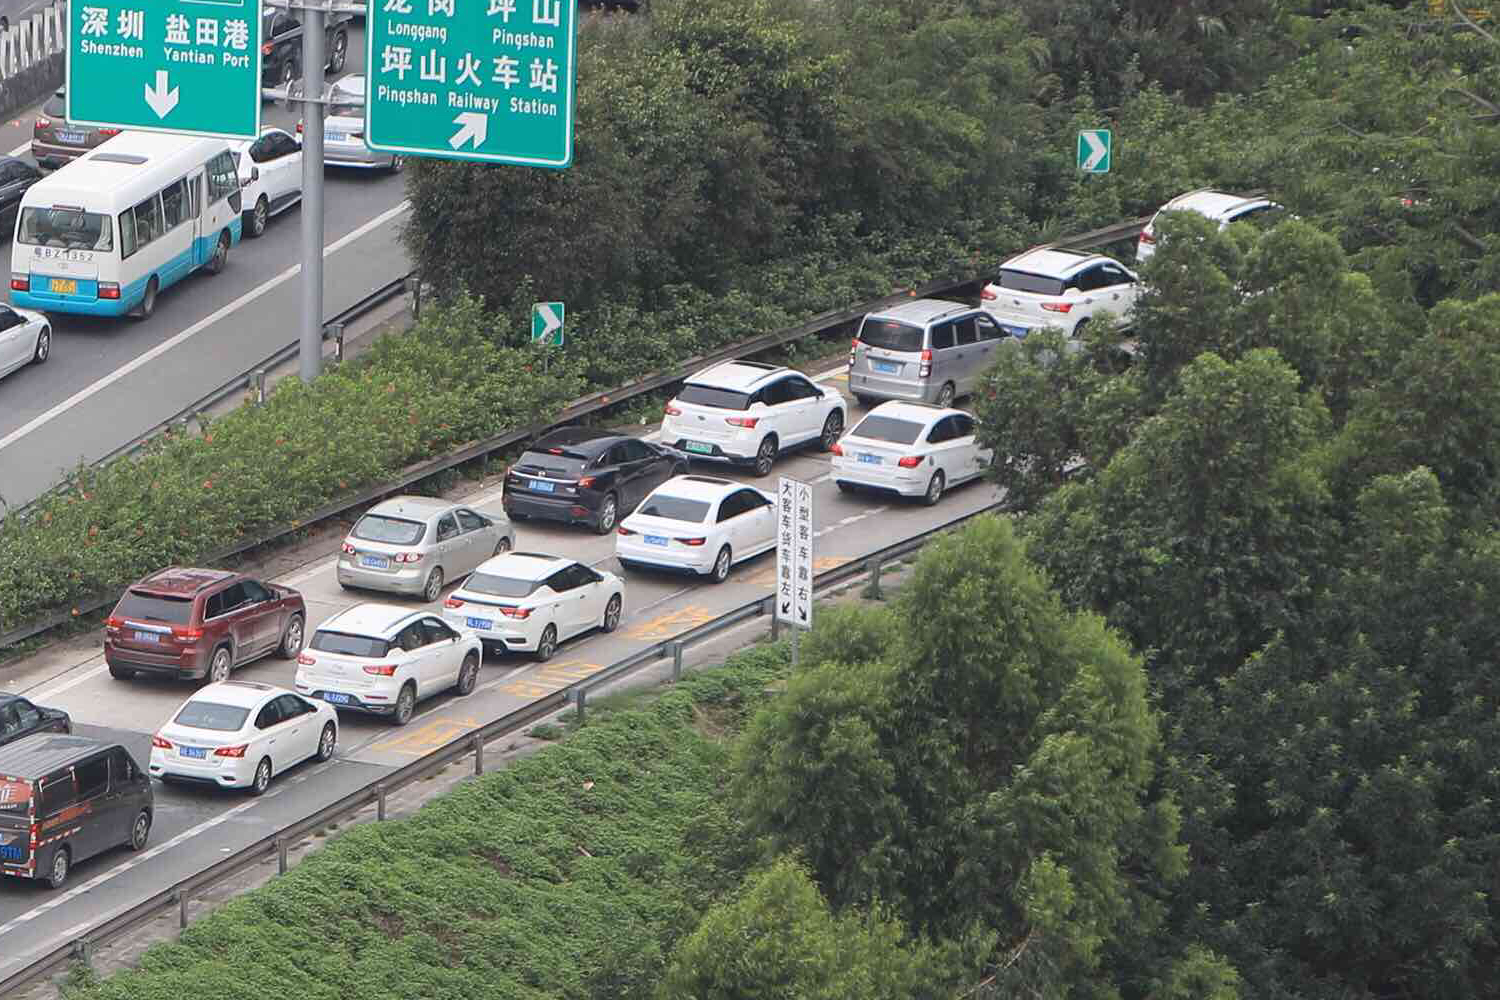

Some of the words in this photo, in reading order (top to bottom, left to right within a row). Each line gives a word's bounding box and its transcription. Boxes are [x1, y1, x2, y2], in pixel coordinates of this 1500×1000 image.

[80, 6, 145, 41] 深圳
[163, 13, 250, 51] 盐田港
[387, 18, 448, 45] Longgang
[492, 27, 555, 50] Pingshan
[80, 38, 145, 59] Shenzhen
[163, 46, 216, 66] Yantian
[222, 51, 250, 69] Port
[380, 44, 559, 93] 坪山火车站
[377, 84, 438, 108] Pingshan
[447, 91, 500, 114] Railway
[509, 96, 558, 116] Station
[781, 481, 792, 597] 大客车货车靠左
[798, 487, 810, 601] 小型客车靠右
